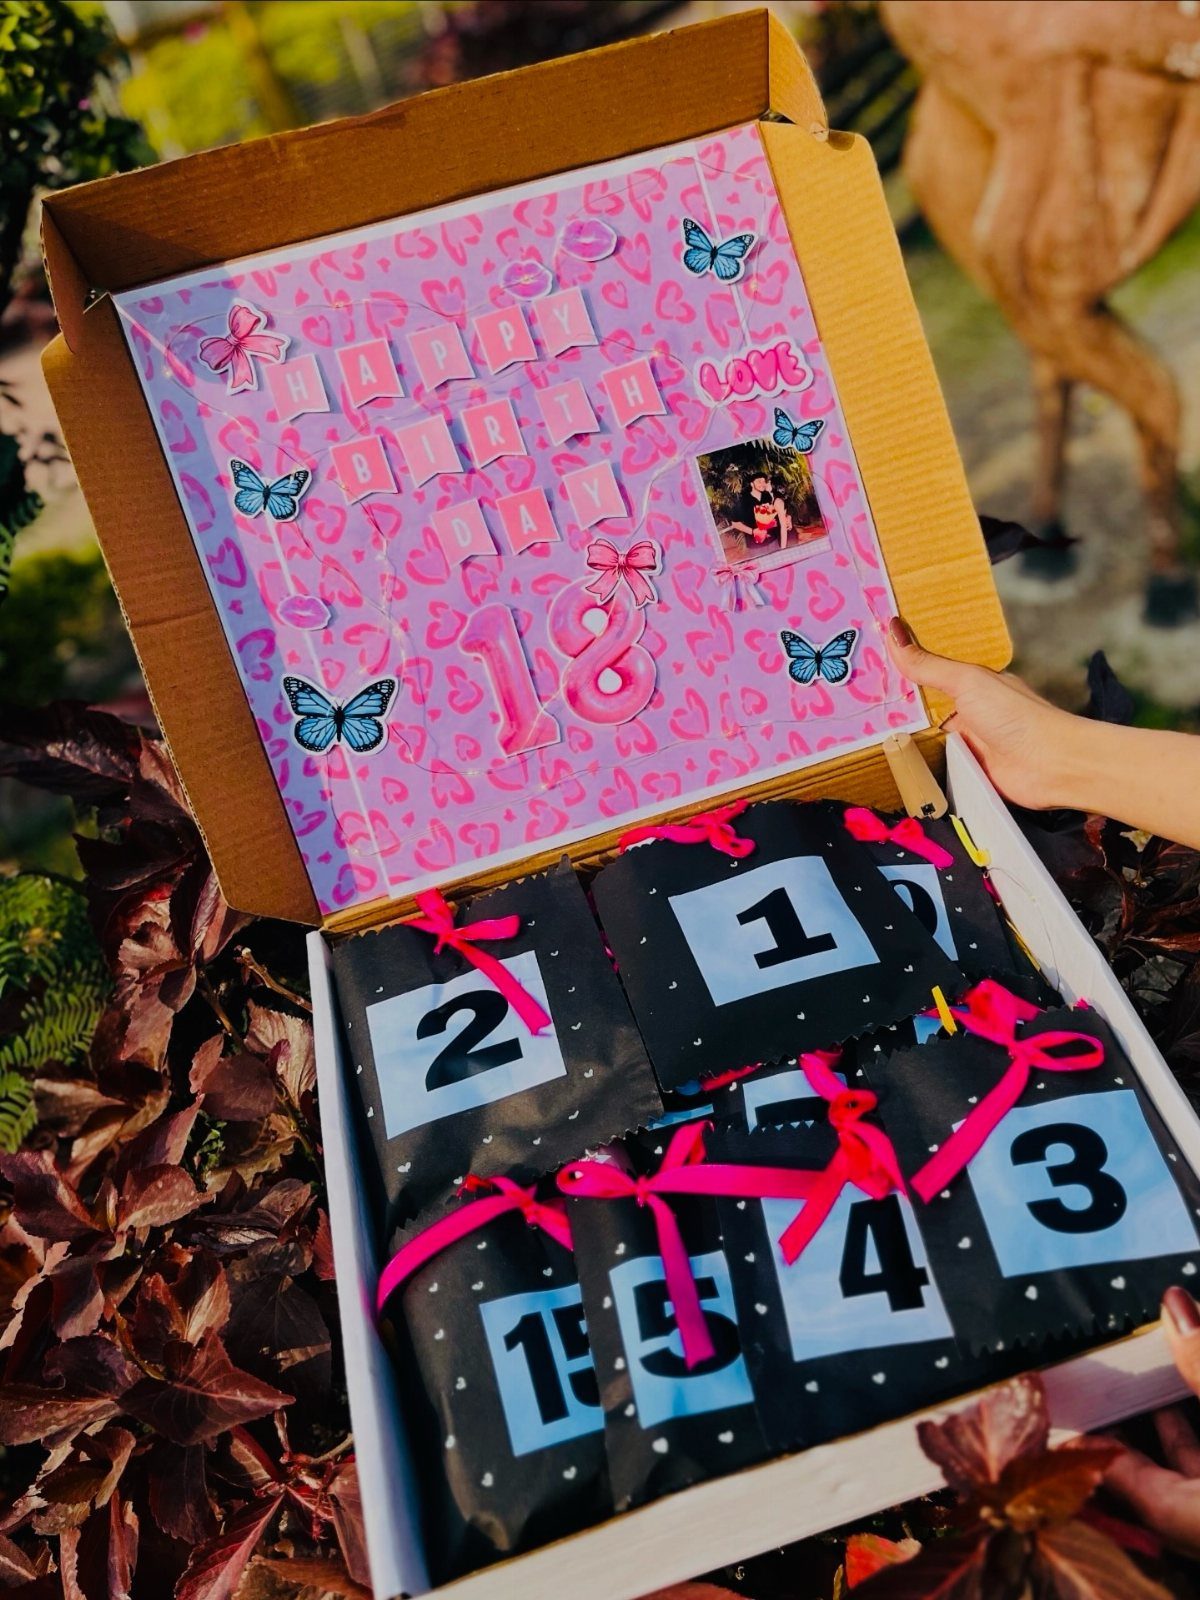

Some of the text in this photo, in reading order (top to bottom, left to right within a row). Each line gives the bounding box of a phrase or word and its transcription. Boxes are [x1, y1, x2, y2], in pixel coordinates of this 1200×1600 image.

[284, 306, 571, 398] HAPPY
[700, 341, 806, 401] LOVE
[352, 375, 645, 484] BIRTH
[451, 478, 600, 548] DAY
[459, 574, 657, 758] 18
[736, 887, 838, 969] 1
[416, 989, 523, 1092] 2
[1010, 1122, 1127, 1234] 3
[839, 1193, 930, 1312] 4
[633, 1276, 742, 1378] 5
